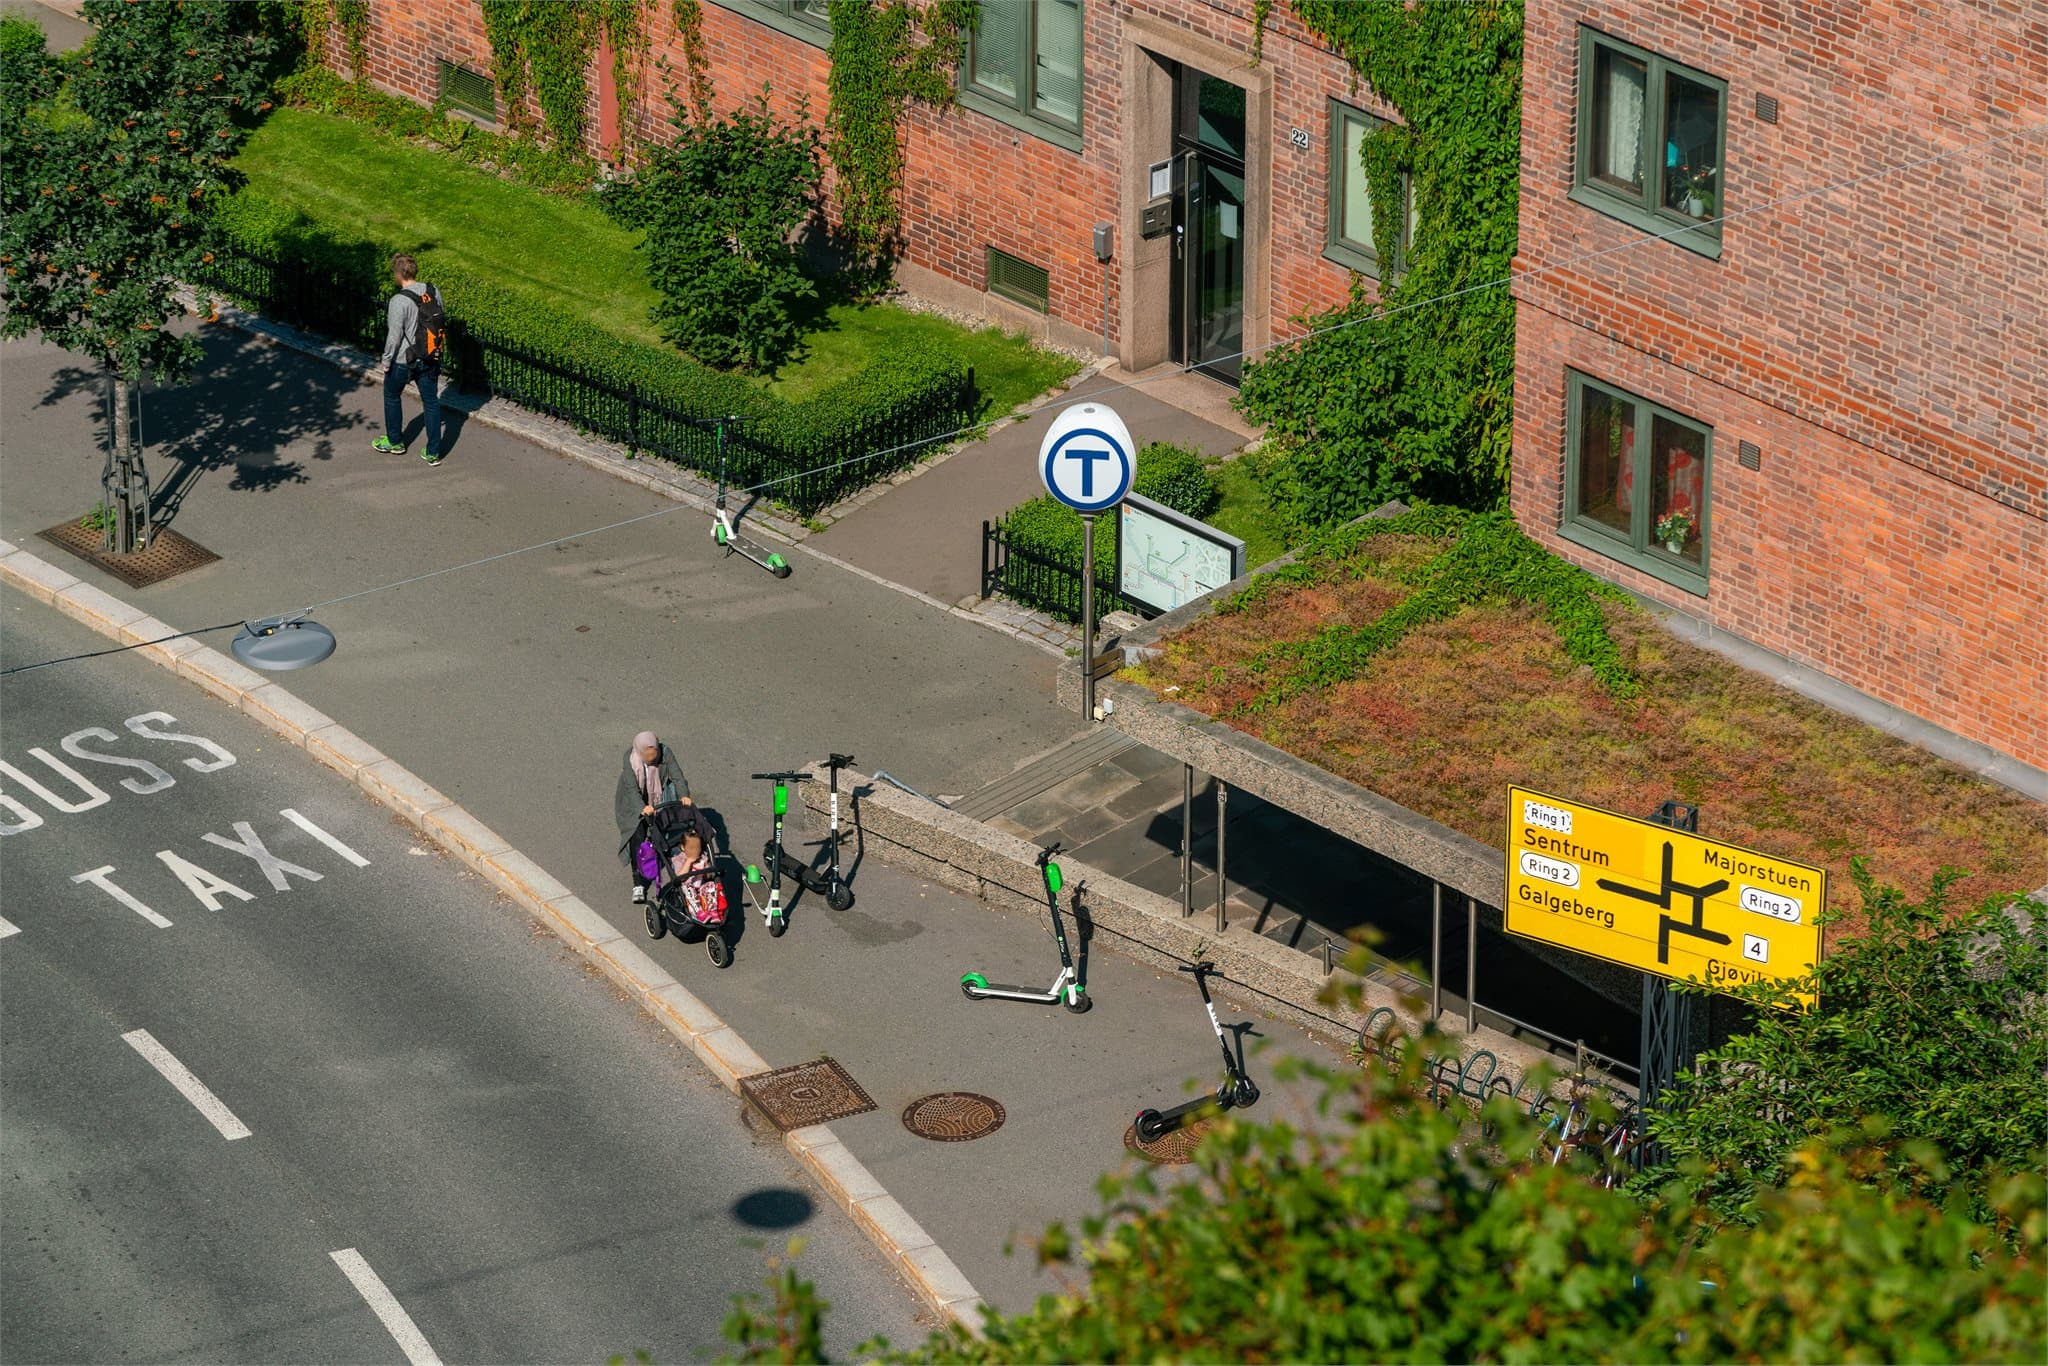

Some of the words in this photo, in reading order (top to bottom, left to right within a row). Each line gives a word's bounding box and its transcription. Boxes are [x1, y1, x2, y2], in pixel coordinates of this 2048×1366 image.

[1292, 129, 1306, 146] 22
[1065, 450, 1109, 497] T
[1531, 808, 1557, 826] Ring
[1560, 816, 1566, 826] 1
[1523, 828, 1609, 867] Sentrum
[70, 808, 371, 929] TAXI
[1529, 859, 1559, 880] Ring
[1562, 869, 1570, 880] 2
[1704, 849, 1810, 892] Majorstuen
[1519, 885, 1615, 928] Galgeberg
[1750, 894, 1780, 915] Ring
[1783, 904, 1792, 915] 2
[1751, 943, 1761, 956] 4
